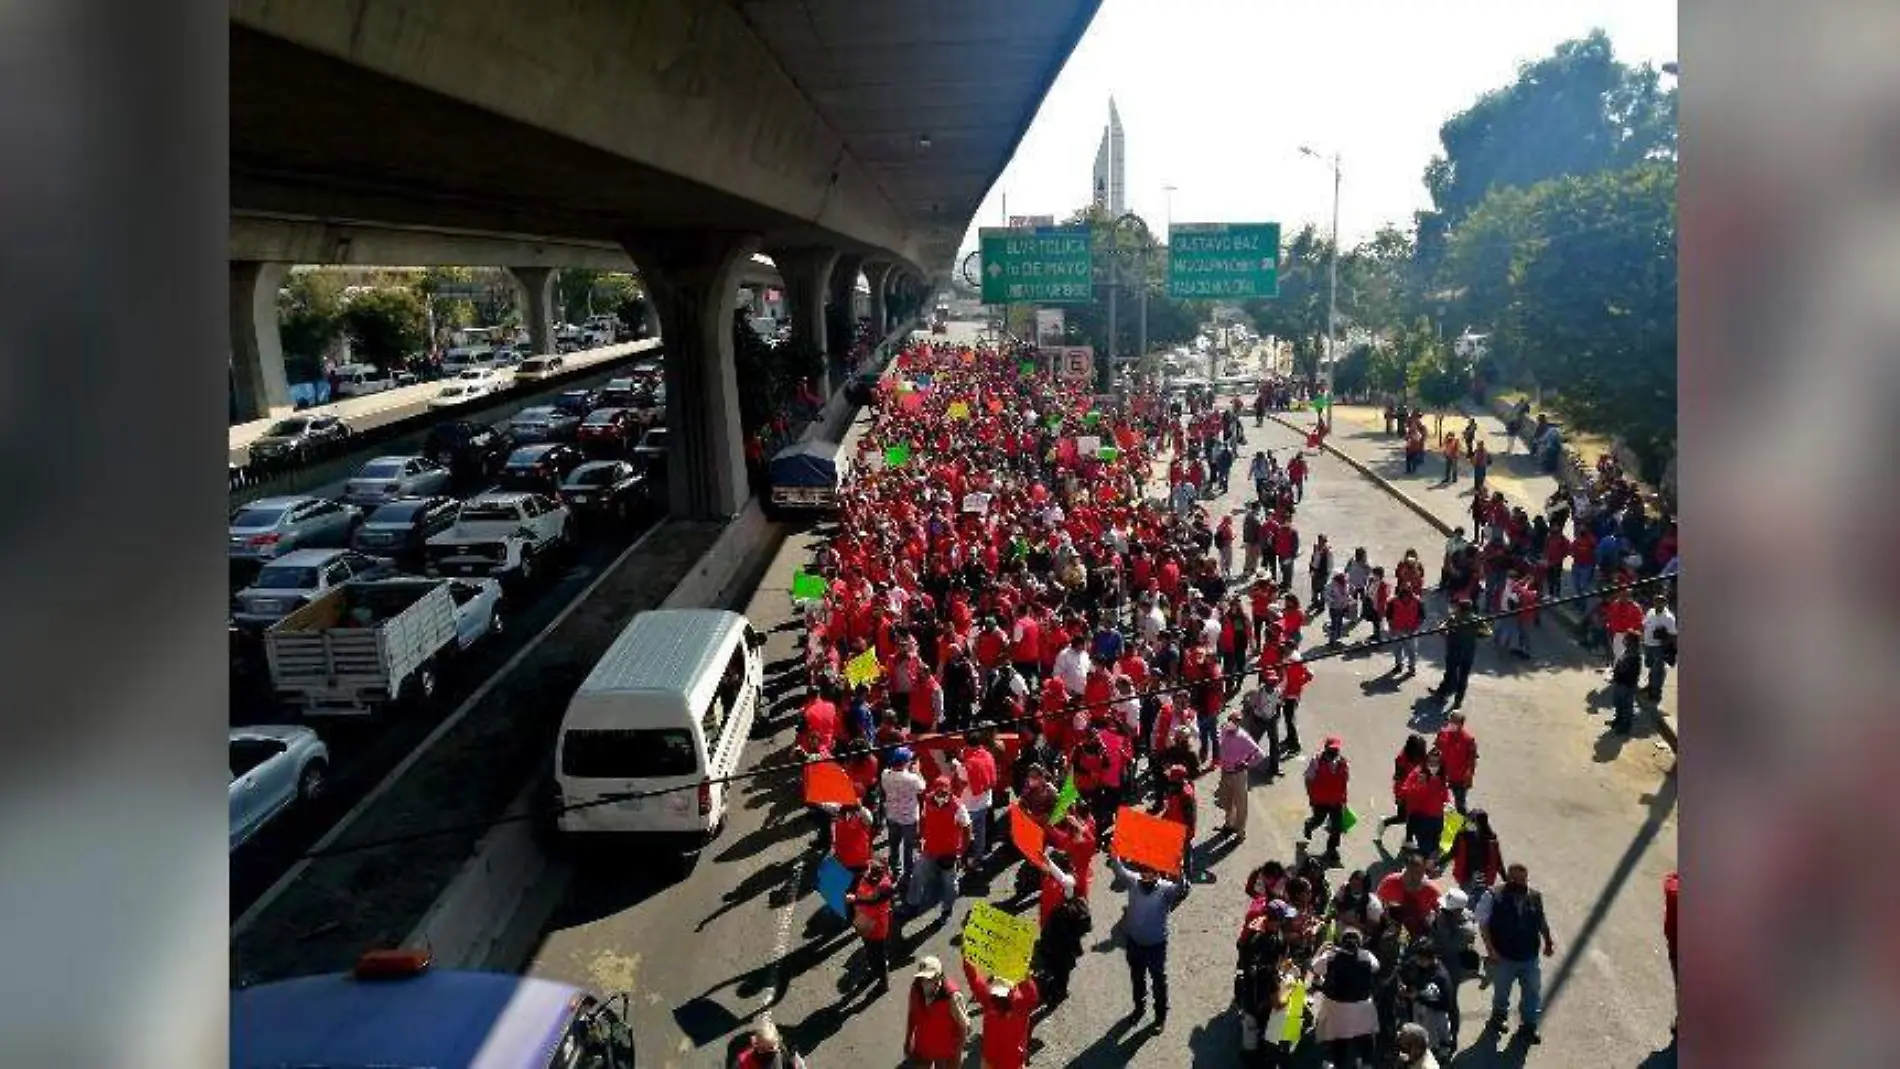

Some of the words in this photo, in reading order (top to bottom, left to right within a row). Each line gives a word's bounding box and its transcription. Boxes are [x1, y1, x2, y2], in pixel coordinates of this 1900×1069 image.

[1233, 234, 1259, 250] BAZ
[1022, 261, 1042, 276] DE
[1044, 261, 1088, 276] MAYO
